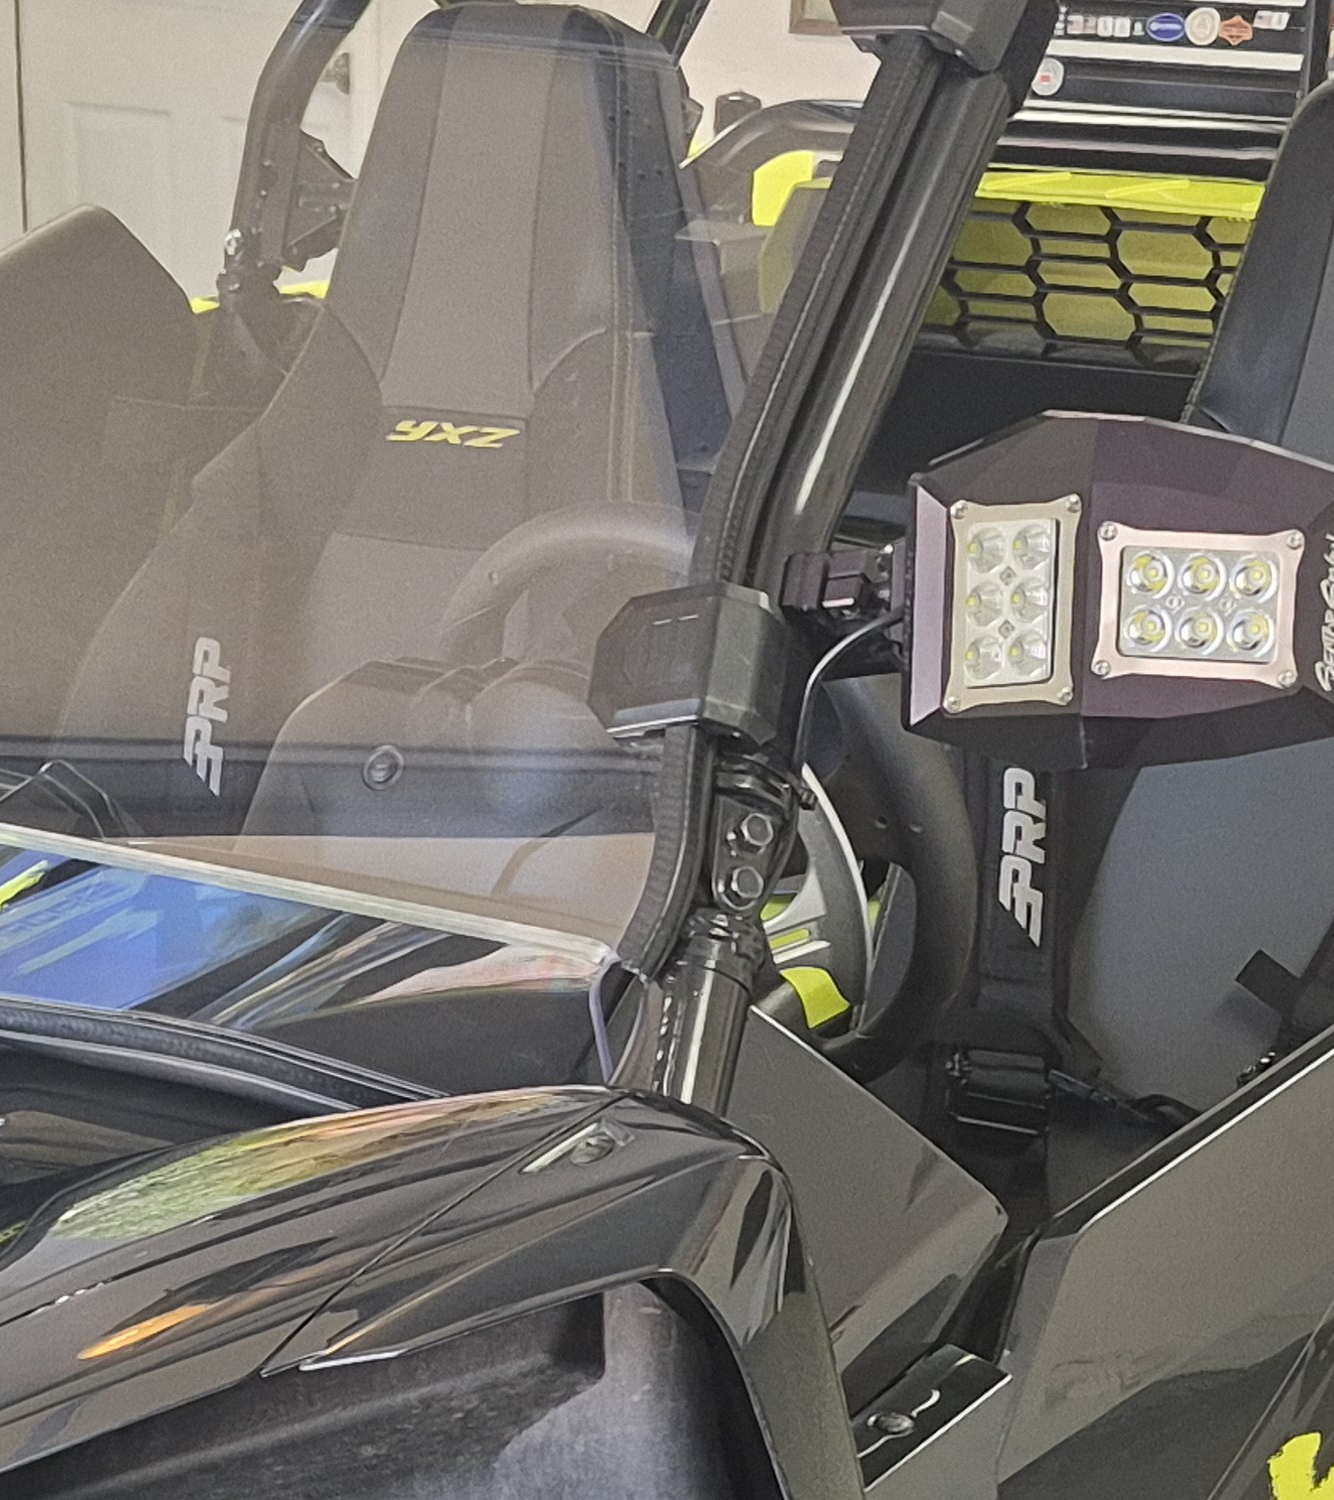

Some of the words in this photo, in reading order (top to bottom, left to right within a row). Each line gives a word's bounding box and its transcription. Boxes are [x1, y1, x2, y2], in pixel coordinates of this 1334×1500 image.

[385, 420, 521, 448] YXZ
[183, 636, 232, 797] PRP
[998, 767, 1047, 947] PRP
